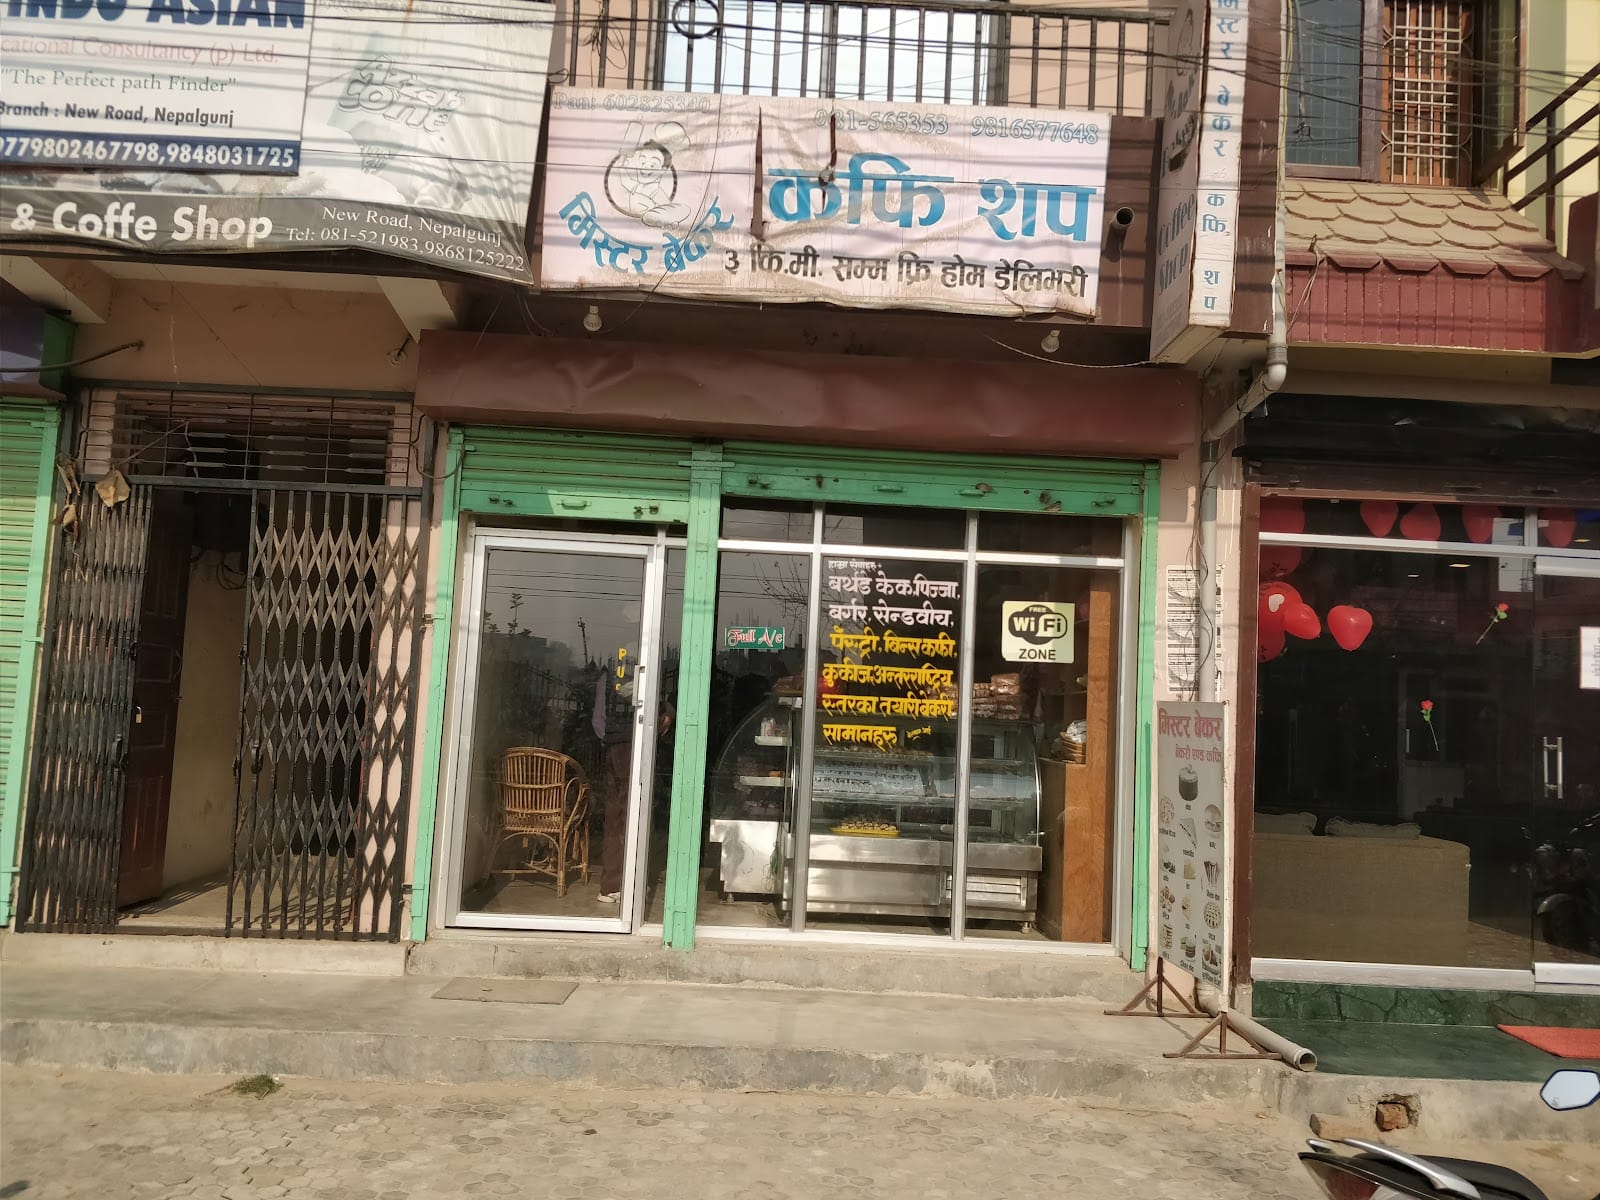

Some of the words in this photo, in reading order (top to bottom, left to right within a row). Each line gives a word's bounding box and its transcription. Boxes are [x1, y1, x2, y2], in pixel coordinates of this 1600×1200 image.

[83, 37, 200, 64] Consultancy
[209, 45, 235, 66] (p)
[243, 43, 279, 63] Ltd.
[1, 67, 45, 84] "The
[53, 69, 115, 88] Perfect
[121, 73, 161, 93] path
[168, 72, 237, 93] Finder"
[64, 102, 99, 119] New
[105, 105, 148, 123] Road,
[154, 106, 234, 128] Nepalgunj
[815, 108, 949, 134] 081-565353
[972, 116, 1099, 144] 9816577648
[0, 137, 293, 167] 779802467798,9848031725
[767, 152, 954, 228] कफि
[978, 178, 1097, 242] शप
[11, 203, 36, 231] &
[53, 202, 157, 241] Coffe
[172, 205, 272, 248] Shop
[287, 228, 315, 241] Tel:
[322, 207, 360, 222] New
[366, 209, 413, 231] Road,
[419, 217, 502, 247] Nepalgunj
[558, 191, 653, 275] मिस्टर
[724, 250, 740, 275] ३
[833, 255, 889, 282] सम्म
[941, 254, 988, 287] होम
[995, 258, 1088, 298] डेलिभरी
[1018, 648, 1057, 661] ZONE
[1158, 707, 1192, 738] मिस्टर
